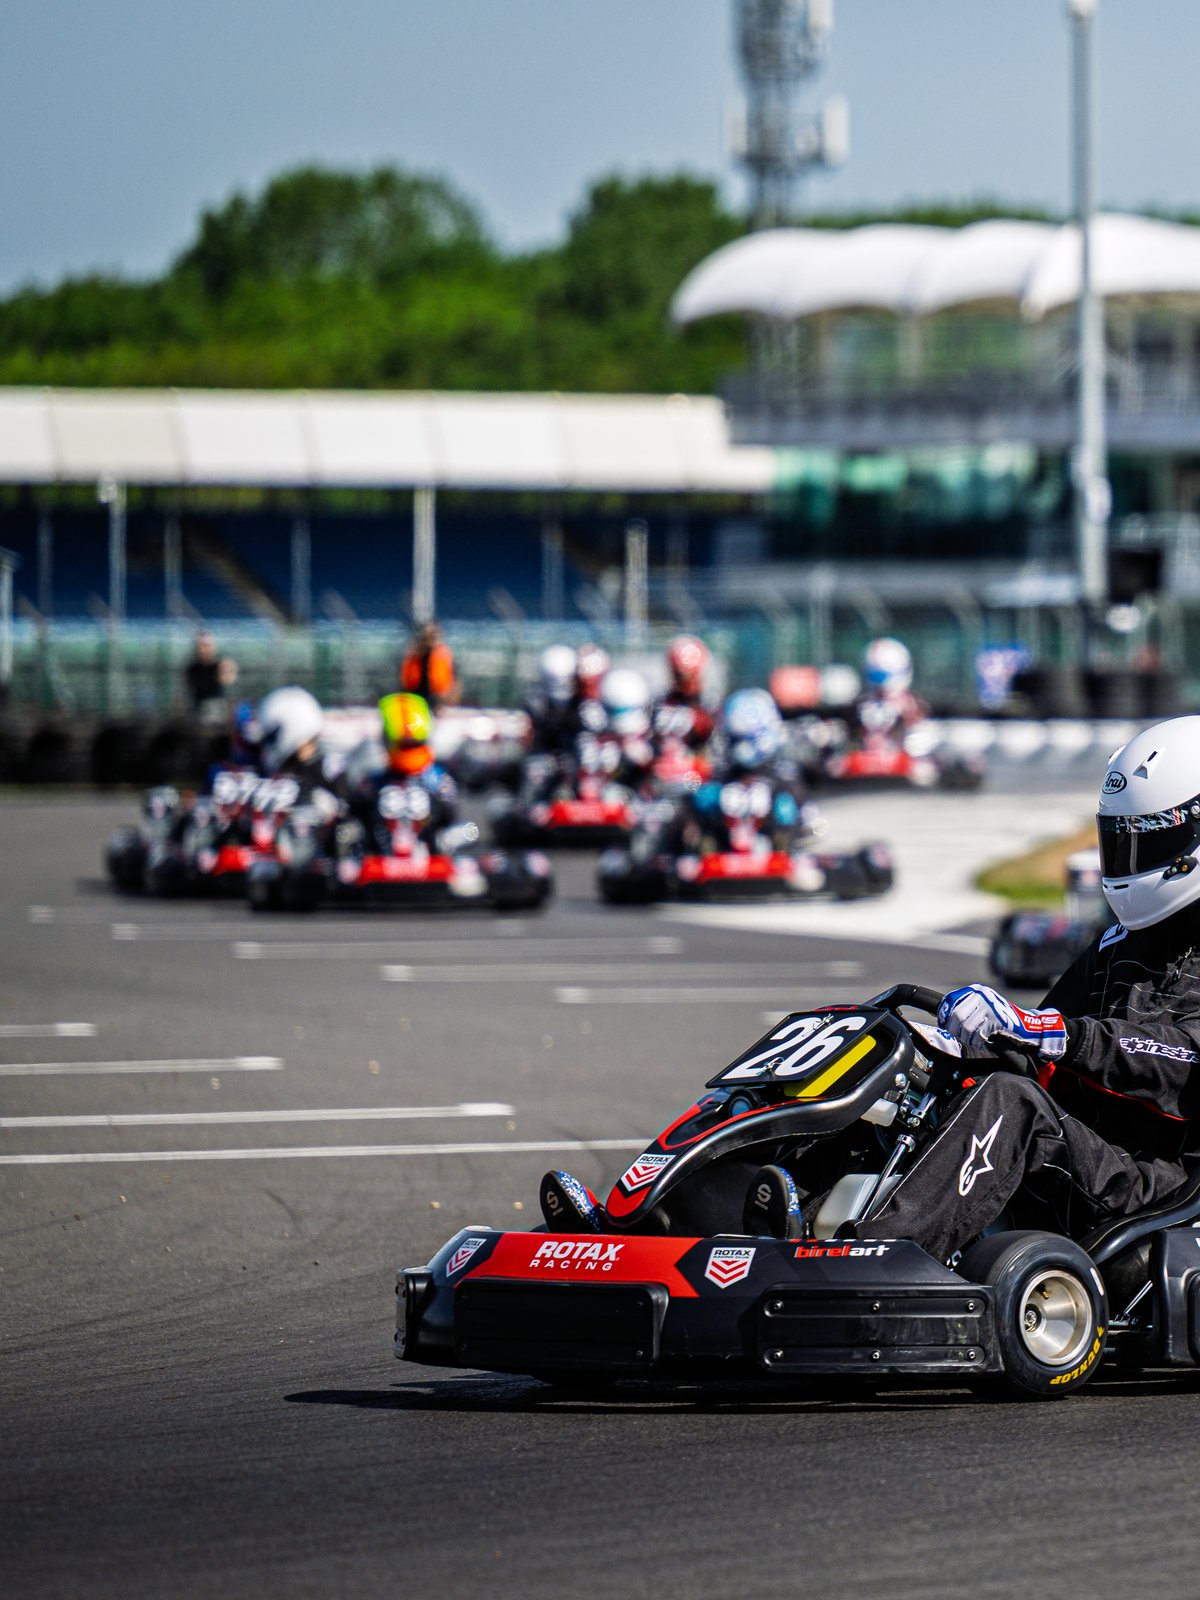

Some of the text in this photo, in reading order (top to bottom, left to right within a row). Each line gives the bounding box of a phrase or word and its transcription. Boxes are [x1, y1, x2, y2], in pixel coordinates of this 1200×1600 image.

[721, 1016, 866, 1079] 26
[529, 1259, 613, 1271] RACING
[534, 1241, 624, 1261] ROTAX
[1049, 1337, 1101, 1385] DUNLOP
